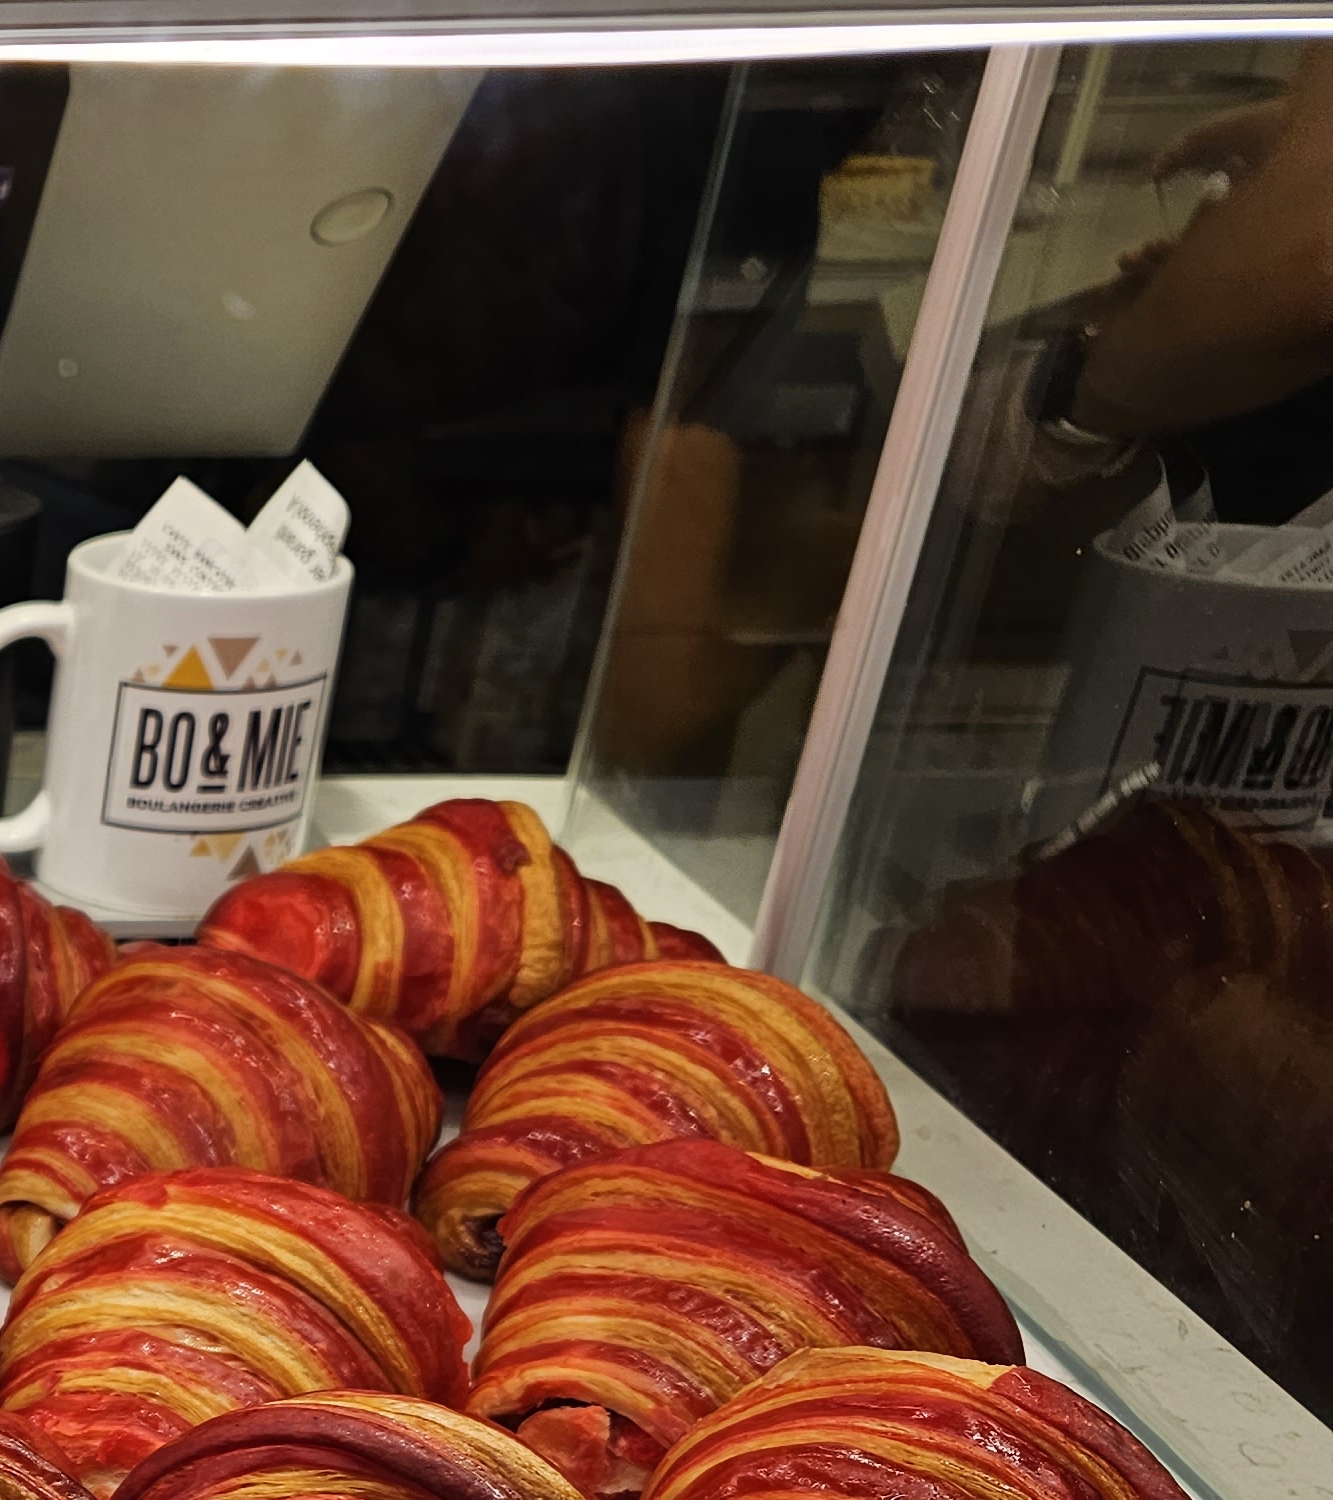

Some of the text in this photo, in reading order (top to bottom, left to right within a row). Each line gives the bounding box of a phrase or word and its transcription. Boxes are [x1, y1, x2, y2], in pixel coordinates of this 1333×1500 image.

[130, 699, 312, 795] BO & MIE
